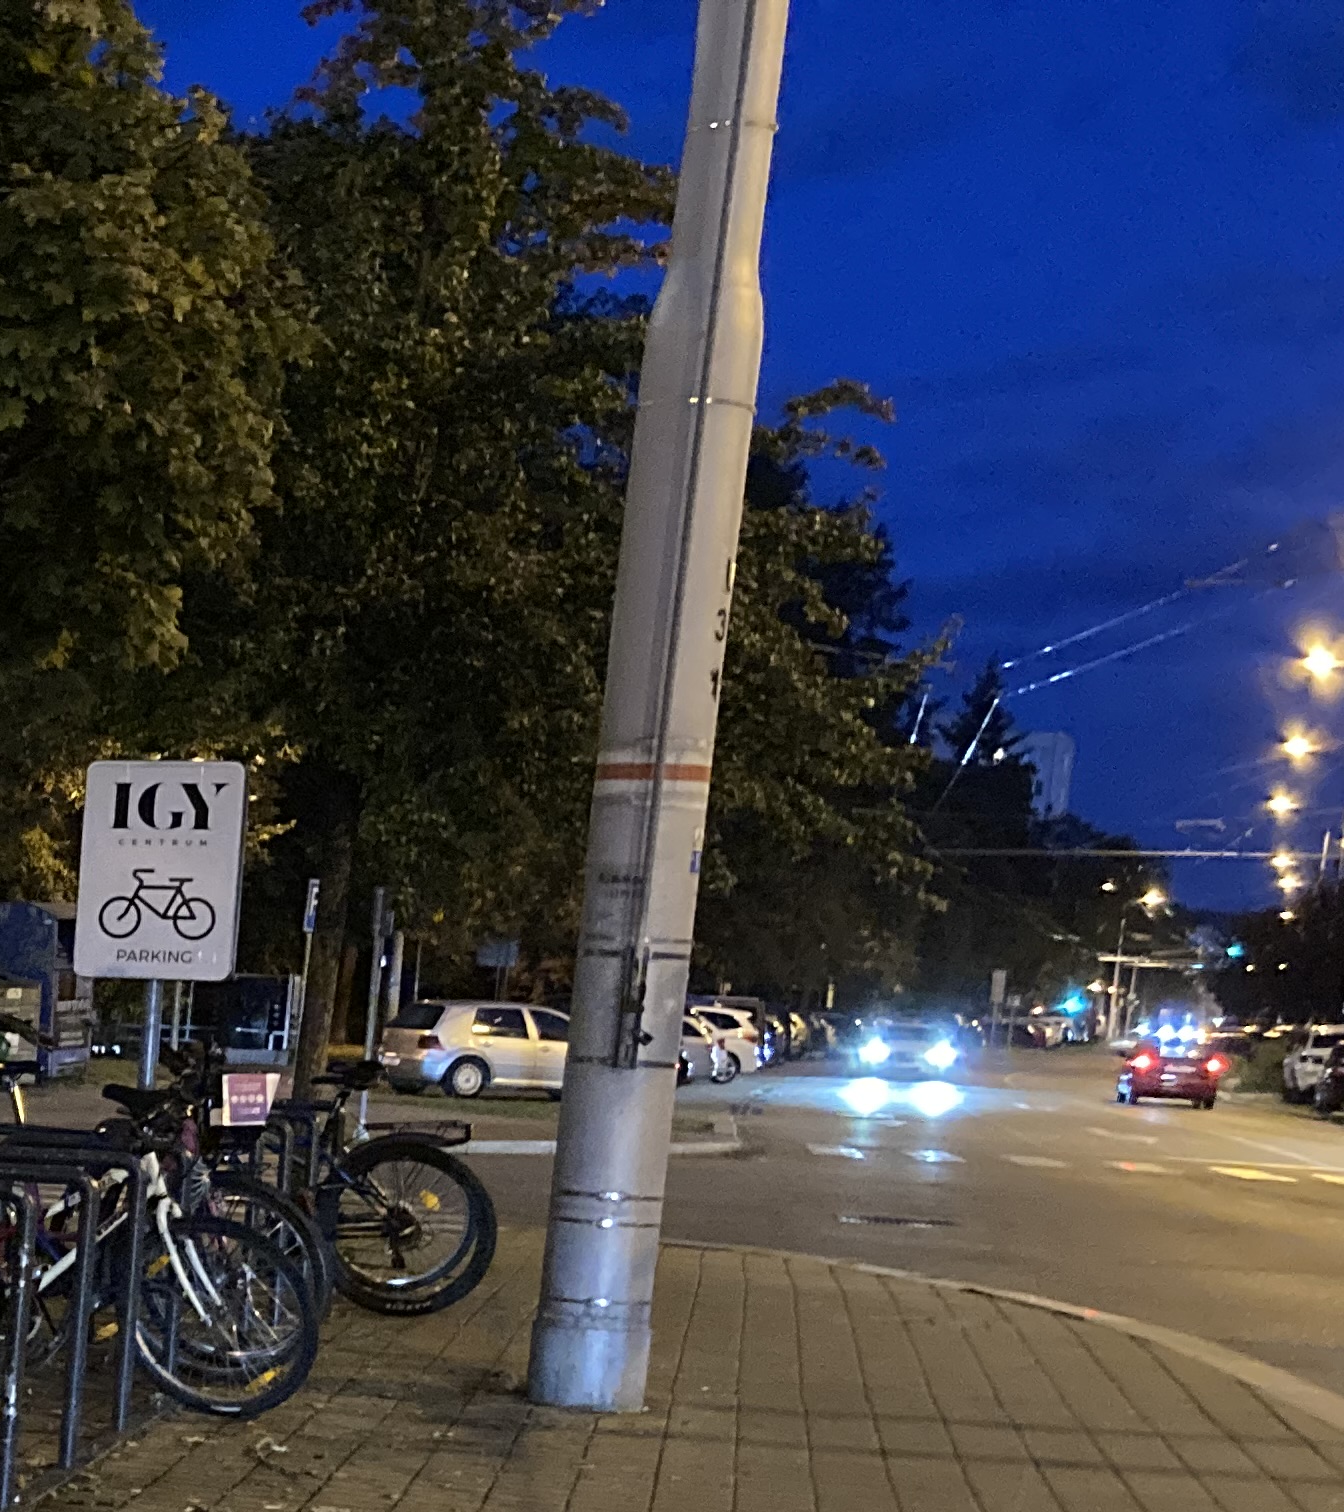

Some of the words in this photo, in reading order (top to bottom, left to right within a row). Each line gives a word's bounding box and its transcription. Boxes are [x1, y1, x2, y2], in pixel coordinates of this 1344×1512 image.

[111, 783, 230, 830] IGY
[118, 838, 208, 847] CENTRUM
[116, 949, 193, 965] PARKING
